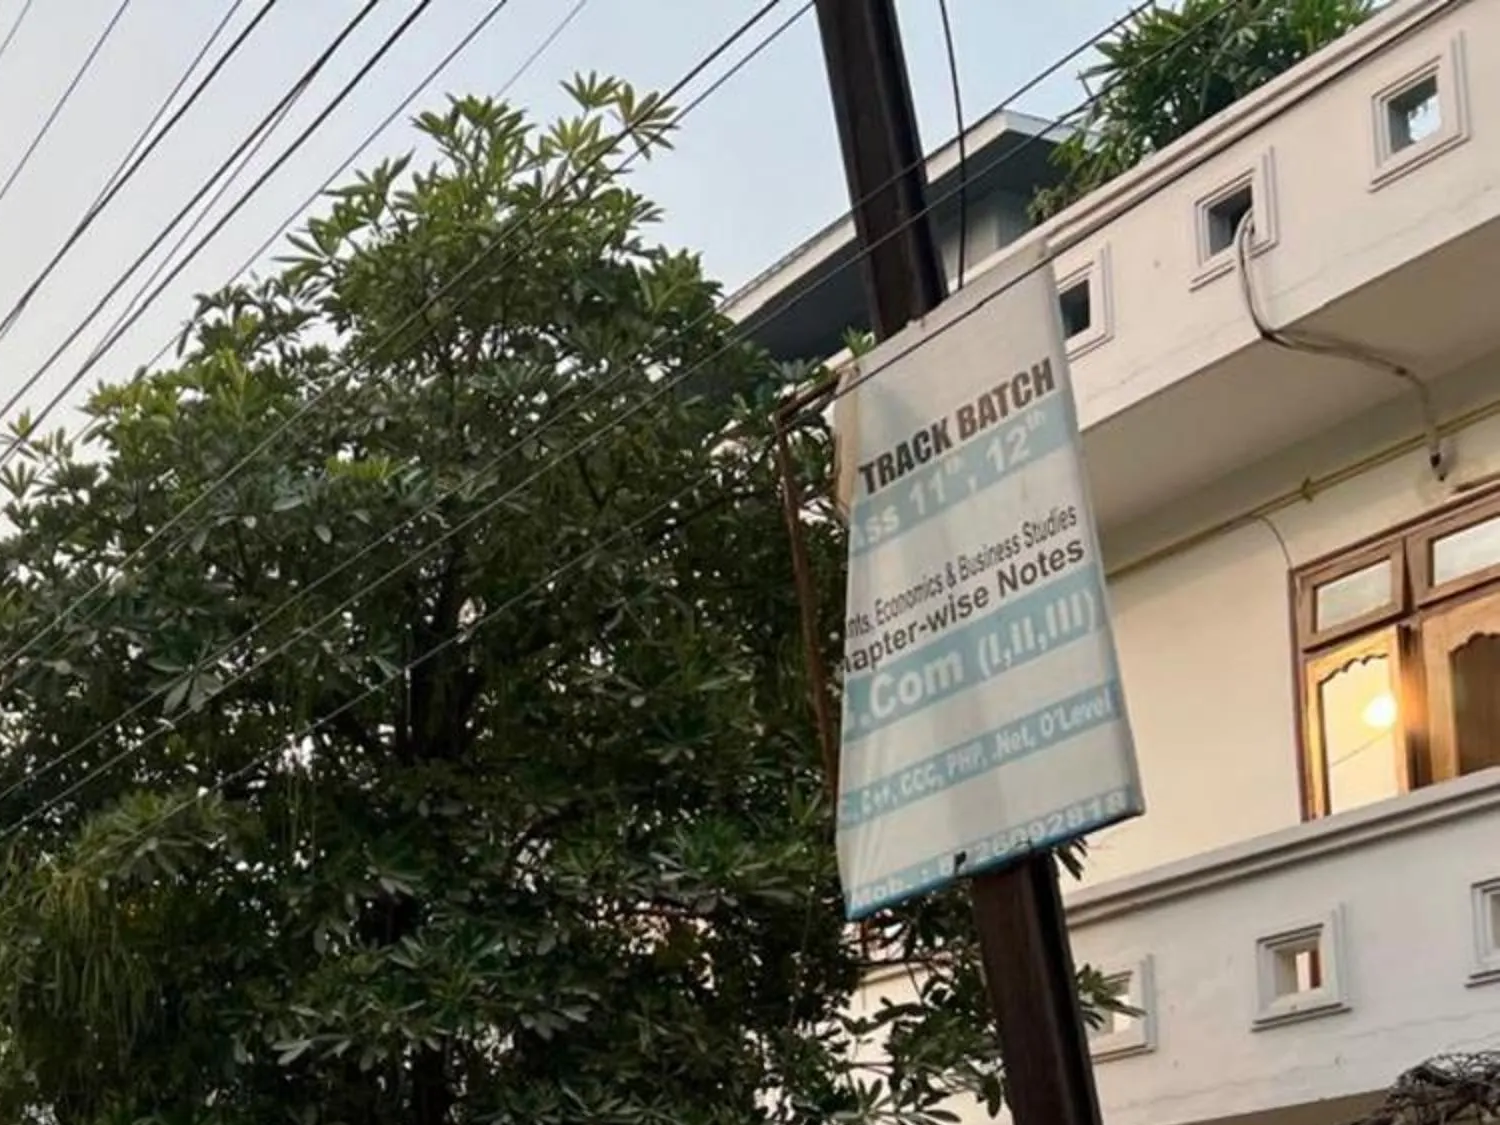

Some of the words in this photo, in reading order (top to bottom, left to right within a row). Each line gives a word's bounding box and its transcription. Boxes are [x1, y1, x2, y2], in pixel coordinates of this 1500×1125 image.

[858, 416, 953, 495] TRACK
[955, 357, 1056, 441] BATCH
[875, 571, 944, 627] Economics
[945, 561, 958, 589] &
[957, 532, 1022, 583] Business
[1021, 504, 1078, 549] Studies
[996, 538, 1086, 599] Notes
[845, 651, 965, 728] .Com
